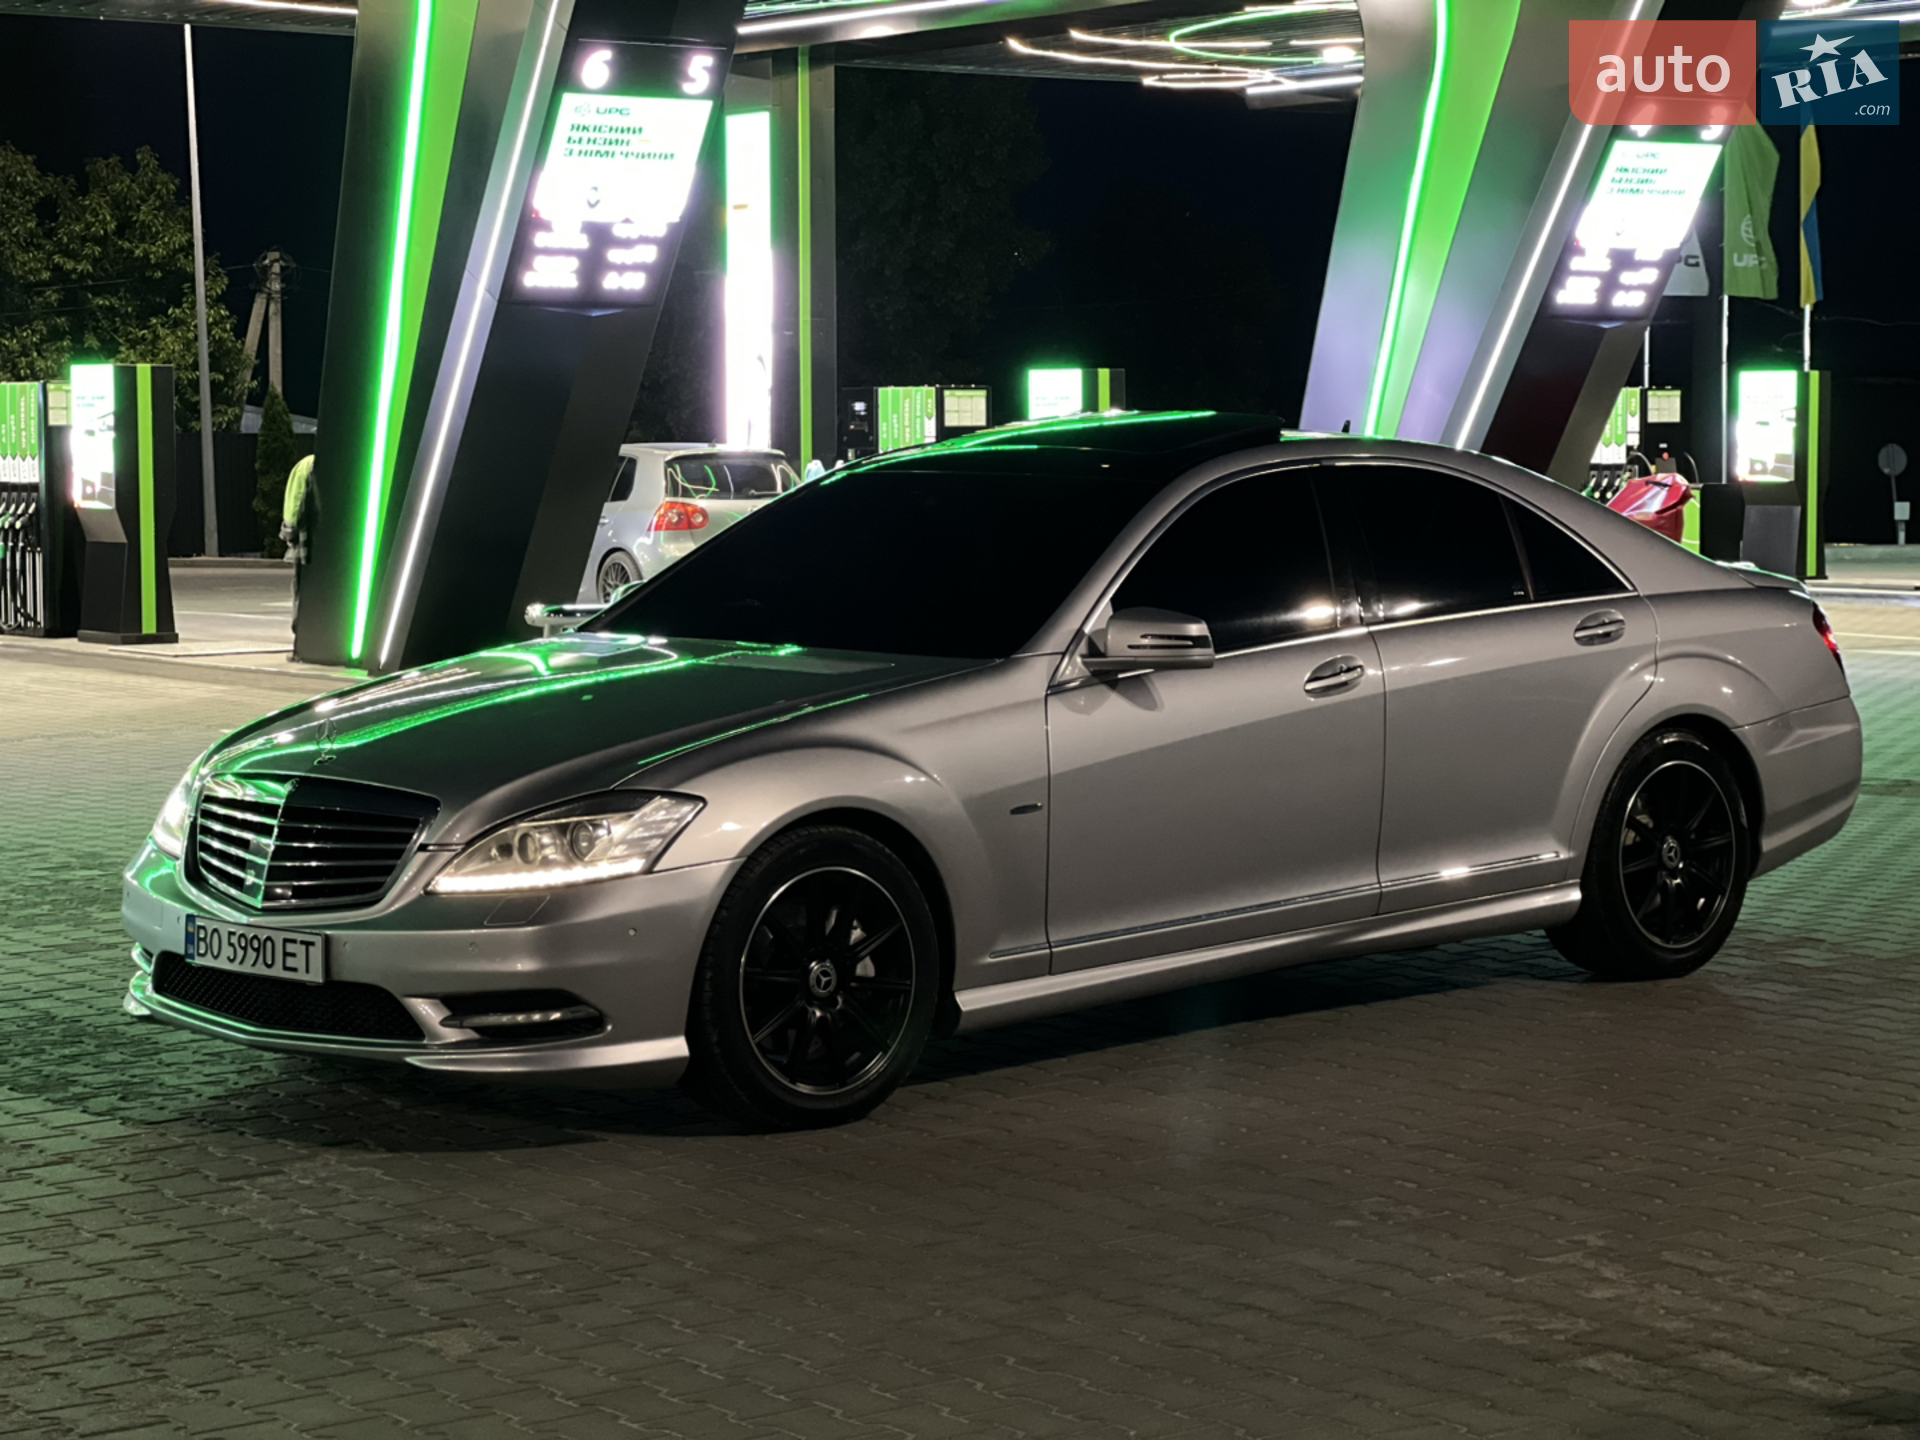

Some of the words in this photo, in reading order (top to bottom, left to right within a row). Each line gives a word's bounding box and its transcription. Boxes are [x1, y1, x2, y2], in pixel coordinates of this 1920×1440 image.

[581, 50, 613, 90] 6
[682, 55, 714, 95] 5
[196, 924, 222, 960] BO
[227, 928, 276, 969] 5990
[282, 937, 316, 974] ET
